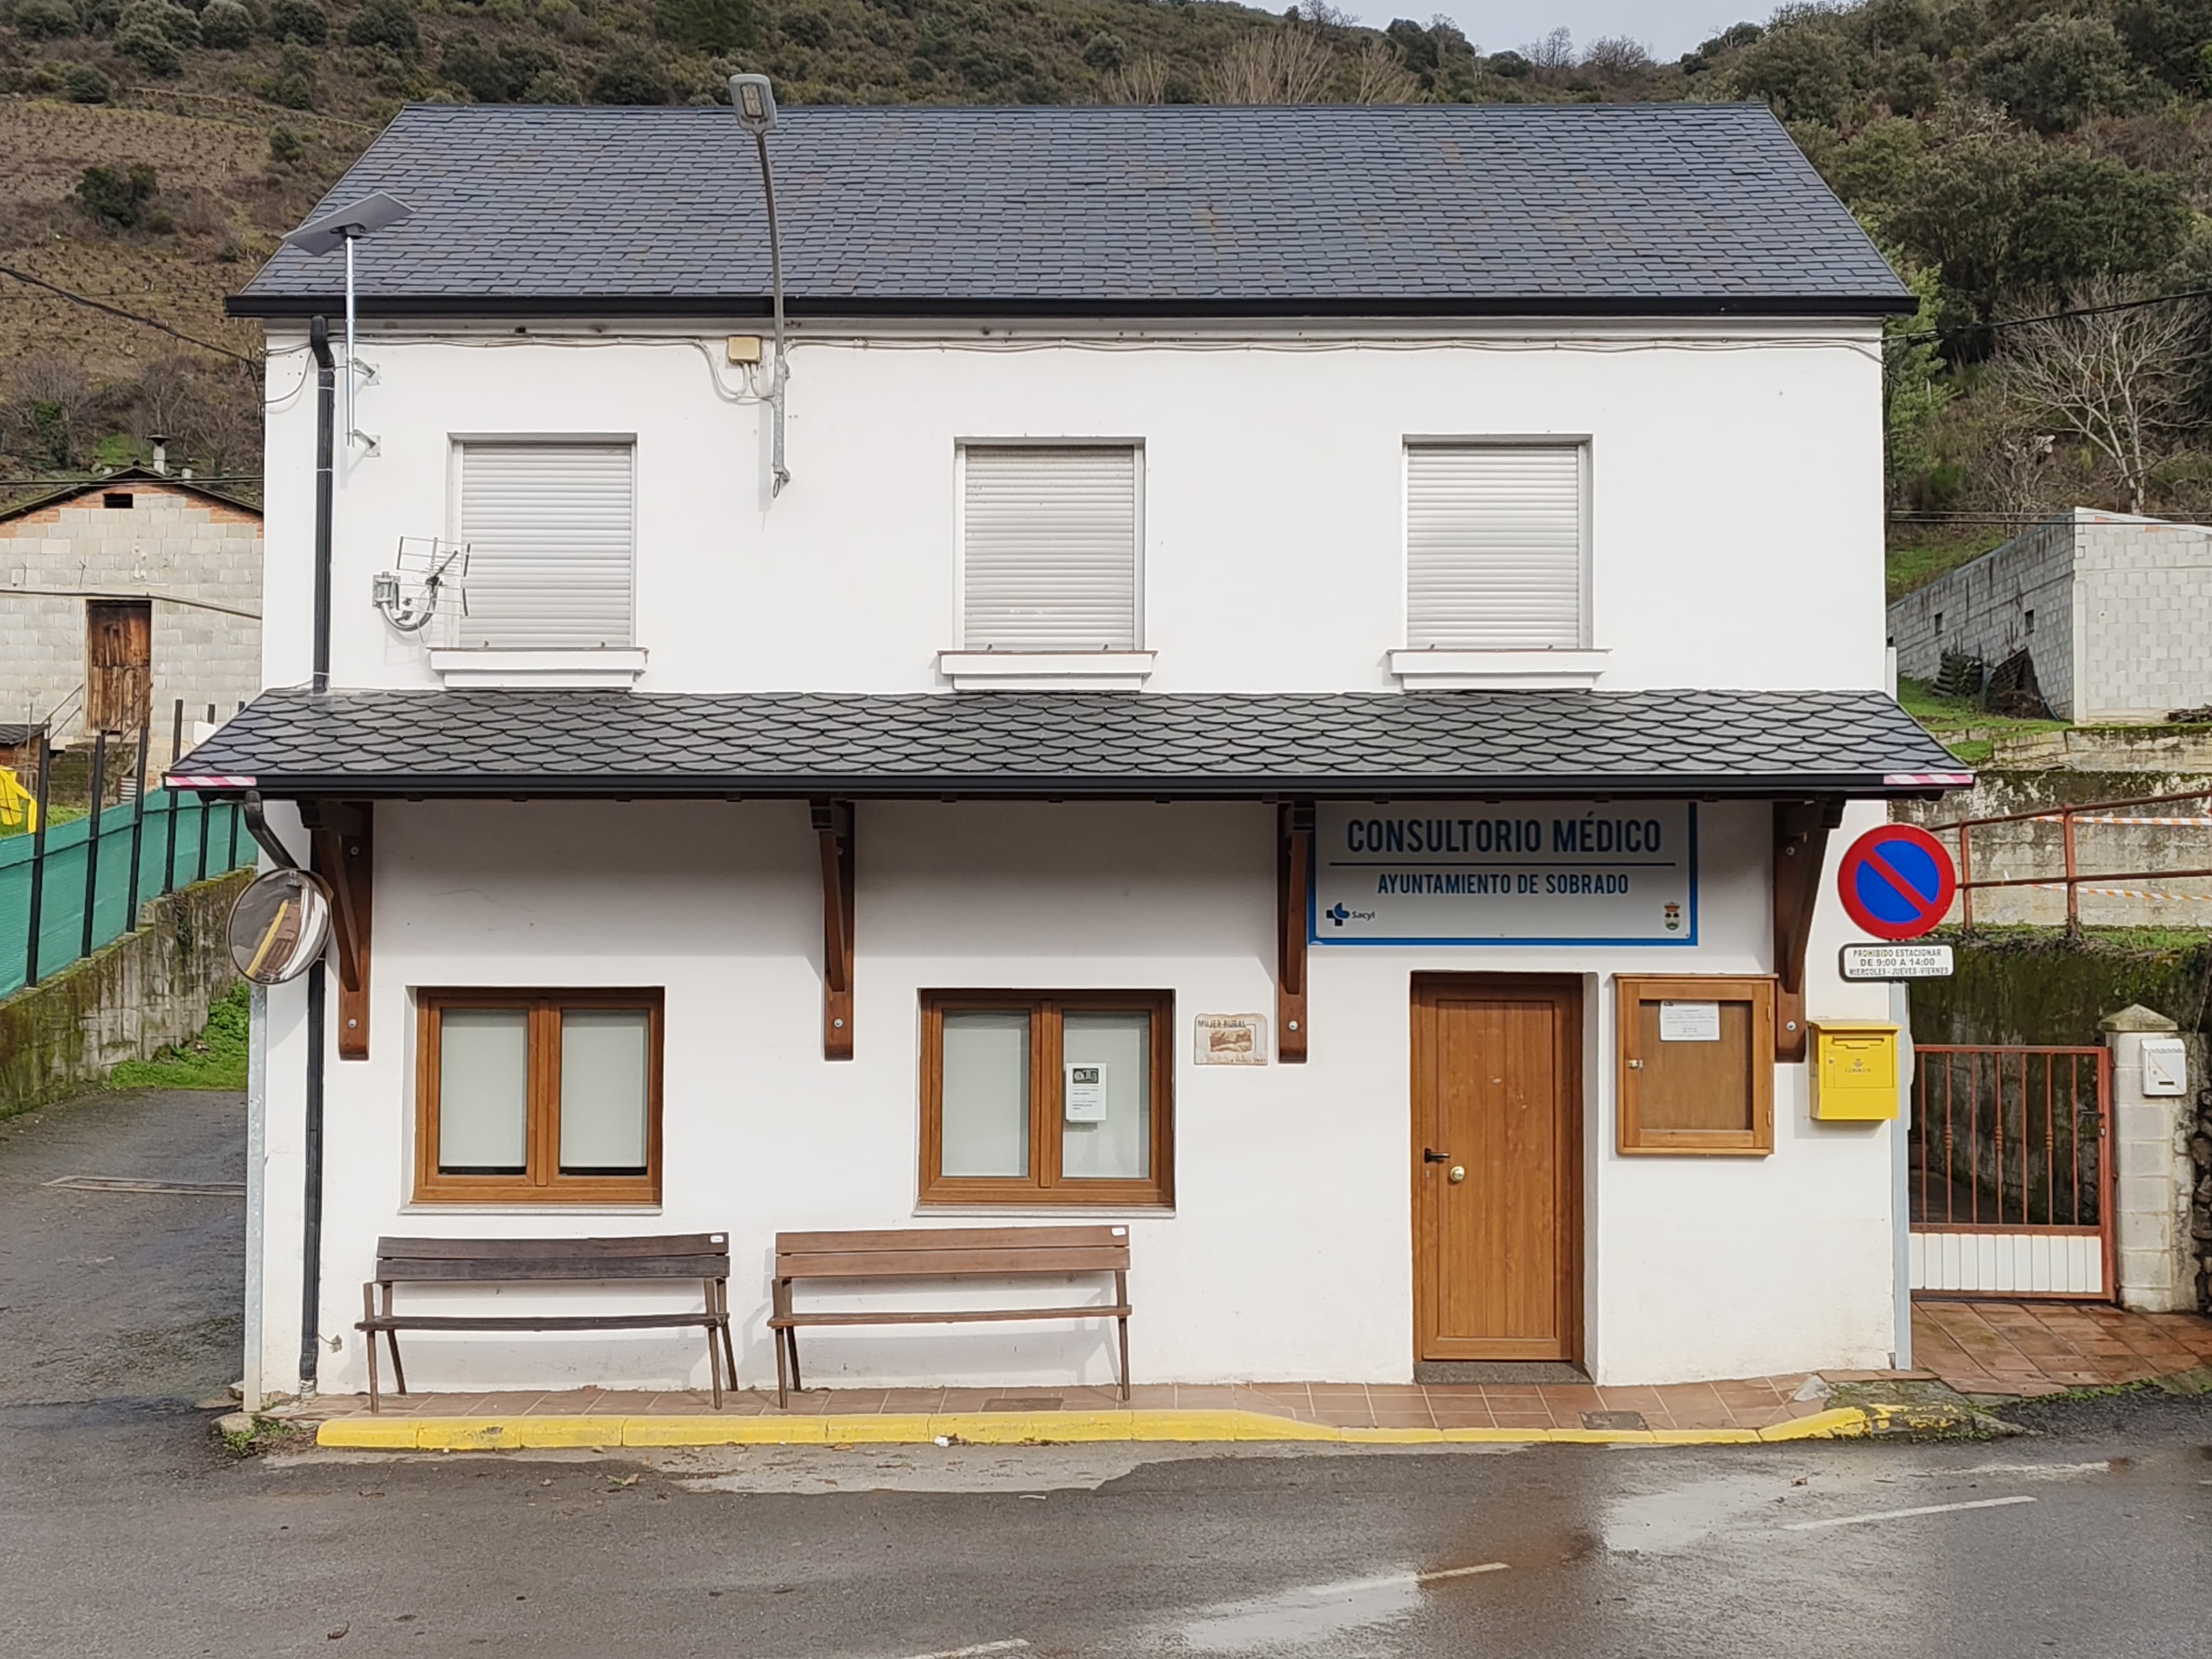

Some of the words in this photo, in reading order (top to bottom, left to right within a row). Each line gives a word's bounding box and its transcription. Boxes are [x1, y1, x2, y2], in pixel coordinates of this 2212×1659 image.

[1347, 819, 1541, 852] CONSULTORIO
[1553, 812, 1661, 852] MÉDICO
[1378, 874, 1510, 894] AYUNTAMIENTO
[1519, 874, 1538, 893] DE
[1546, 874, 1628, 893] SOBRADO
[1352, 911, 1375, 921] Sacyl
[1853, 949, 1893, 957] PROHIBIDO
[1896, 949, 1941, 957] ESTACIONAR
